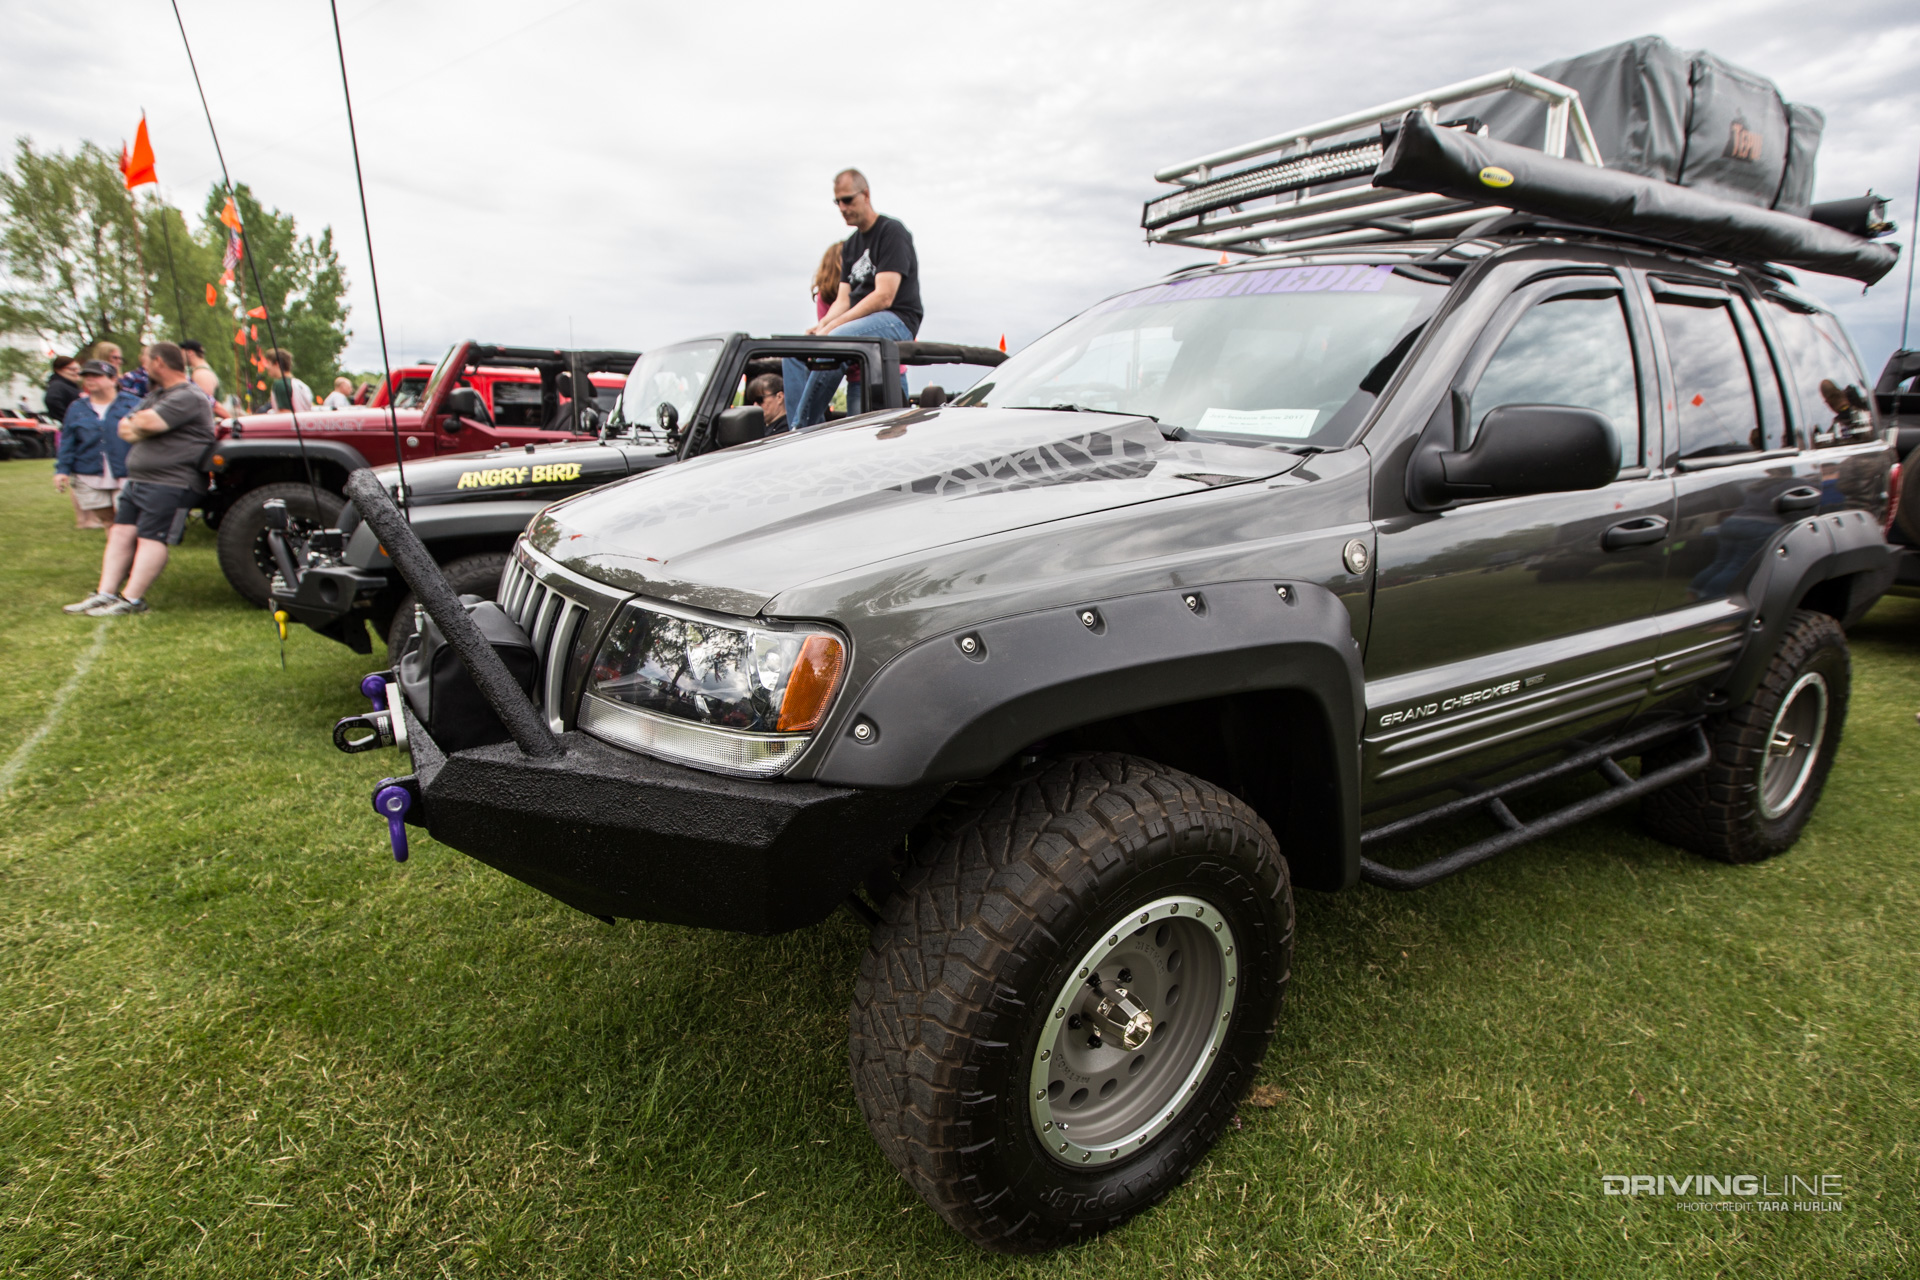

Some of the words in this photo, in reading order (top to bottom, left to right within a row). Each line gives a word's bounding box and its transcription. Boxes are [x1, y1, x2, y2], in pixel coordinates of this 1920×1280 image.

[457, 466, 529, 489] ANGRY
[532, 463, 582, 483] BIRD
[1380, 703, 1438, 727] GRAND
[1441, 680, 1521, 711] CHEROKEE
[1135, 941, 1164, 975] METHOD
[1055, 1052, 1091, 1084] METHOD
